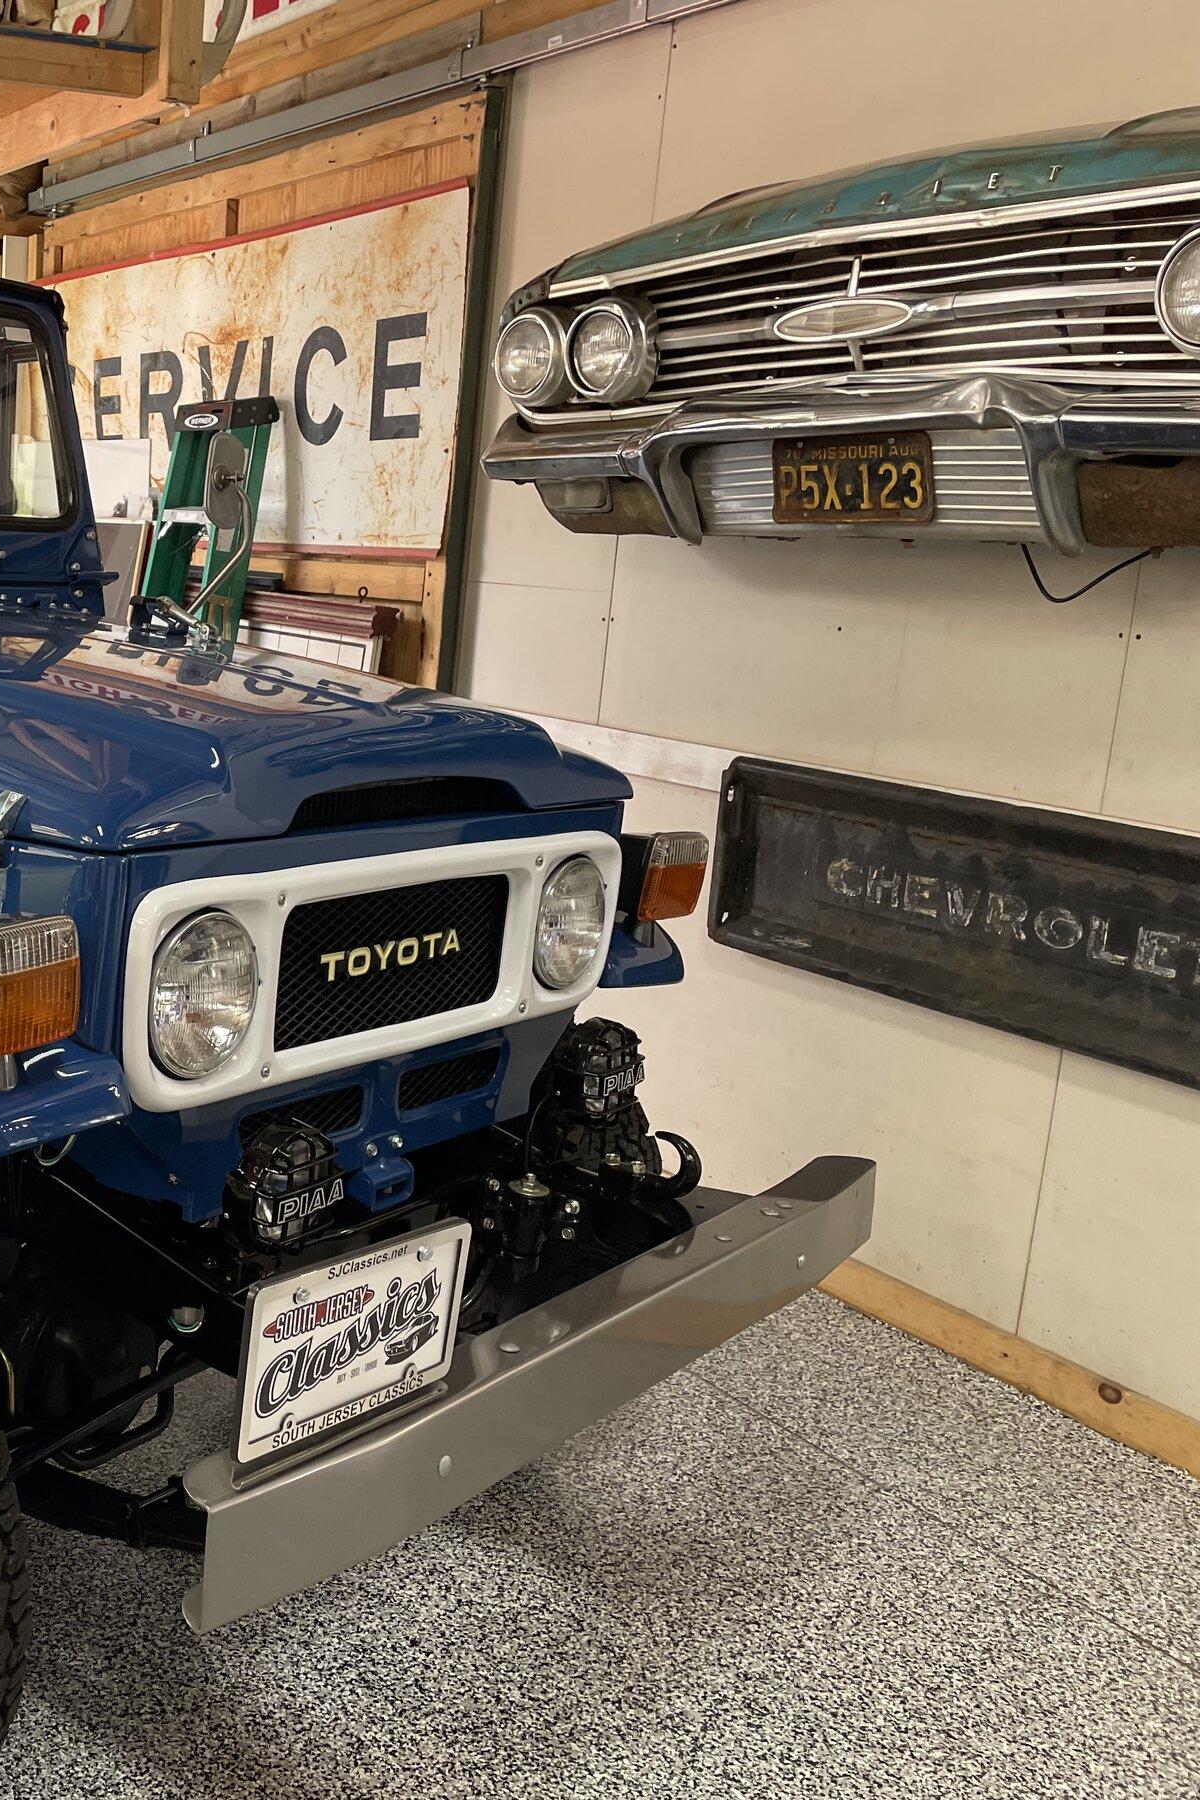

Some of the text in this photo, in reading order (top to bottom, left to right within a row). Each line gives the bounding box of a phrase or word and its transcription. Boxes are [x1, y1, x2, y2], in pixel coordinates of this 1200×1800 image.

[70, 312, 428, 451] ERVICE
[811, 445, 883, 460] MISSOURI
[827, 858, 1200, 985] CHEVROLE
[320, 928, 461, 982] TOYOTA
[603, 1063, 645, 1097] PIAA
[277, 1178, 344, 1224] PIAA
[327, 1244, 408, 1280] SJClassics.net
[274, 1284, 369, 1343] SOUTH JERSEY
[255, 1268, 441, 1418] Classics
[272, 1374, 424, 1450] SOUTH JERSEY CLASSICS
